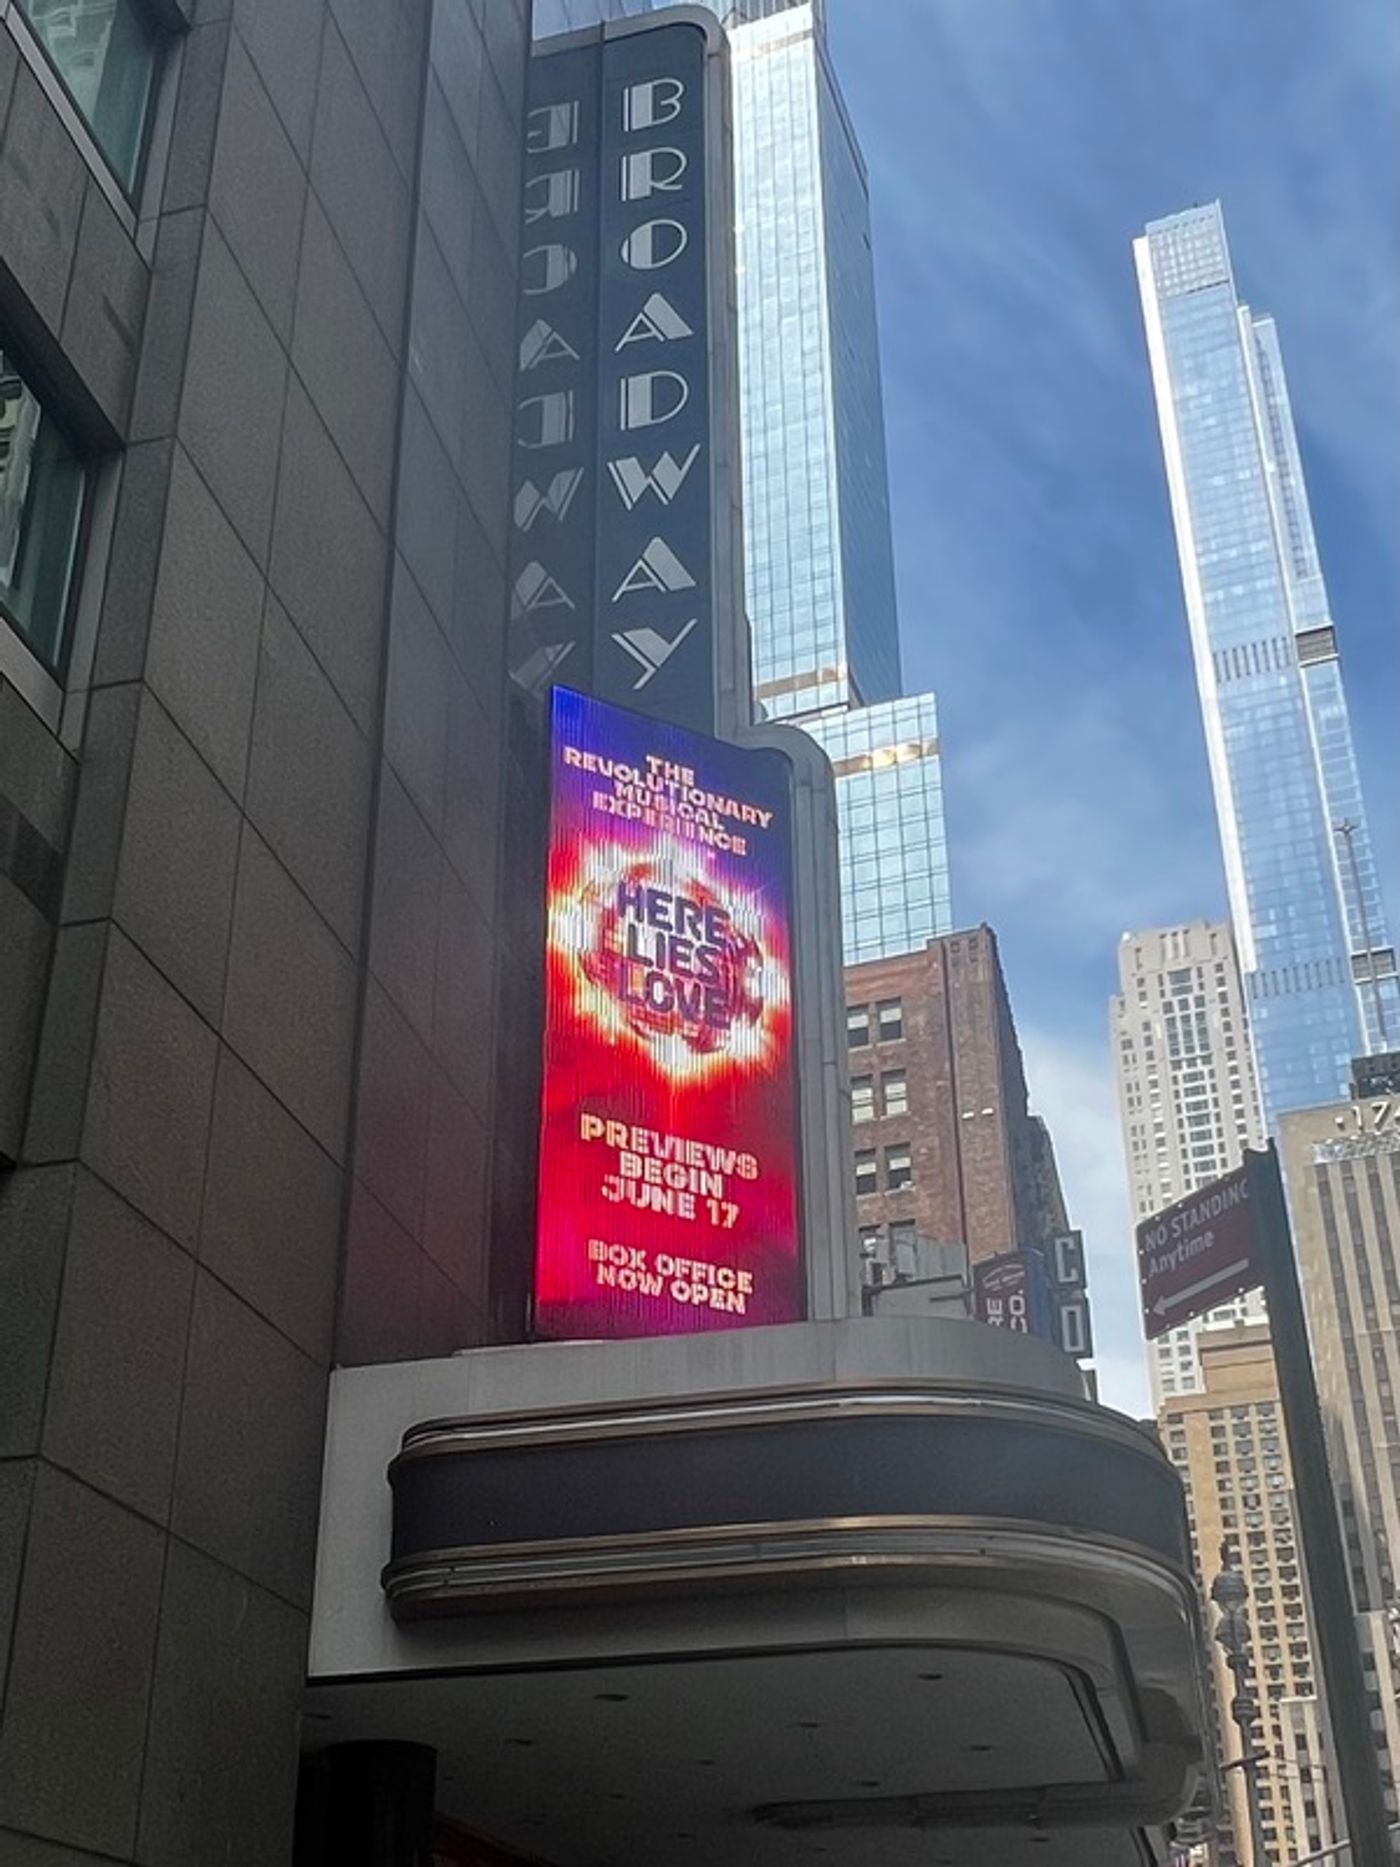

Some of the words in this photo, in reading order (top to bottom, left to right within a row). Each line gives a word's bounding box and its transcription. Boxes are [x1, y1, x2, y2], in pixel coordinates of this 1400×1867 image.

[607, 77, 700, 690] BROADWAY
[563, 746, 773, 829] REVOLUTIONARY
[646, 754, 694, 787] THE
[614, 781, 726, 831] MUSICAL
[617, 879, 731, 949] HERE
[627, 923, 720, 986] LIES
[619, 962, 731, 1030] LOVE
[1352, 1101, 1400, 1127] 17
[580, 1113, 759, 1180] PREVIEWS
[601, 1174, 696, 1220] JUNE
[706, 1198, 740, 1229] 17
[619, 1150, 724, 1199] BEGIN
[1144, 1224, 1168, 1251] NO
[1149, 1230, 1215, 1277] Anytime
[588, 1239, 647, 1271] BOX
[654, 1253, 753, 1294] OFFICE
[596, 1263, 664, 1296] NOW
[669, 1279, 746, 1315] OPEN
